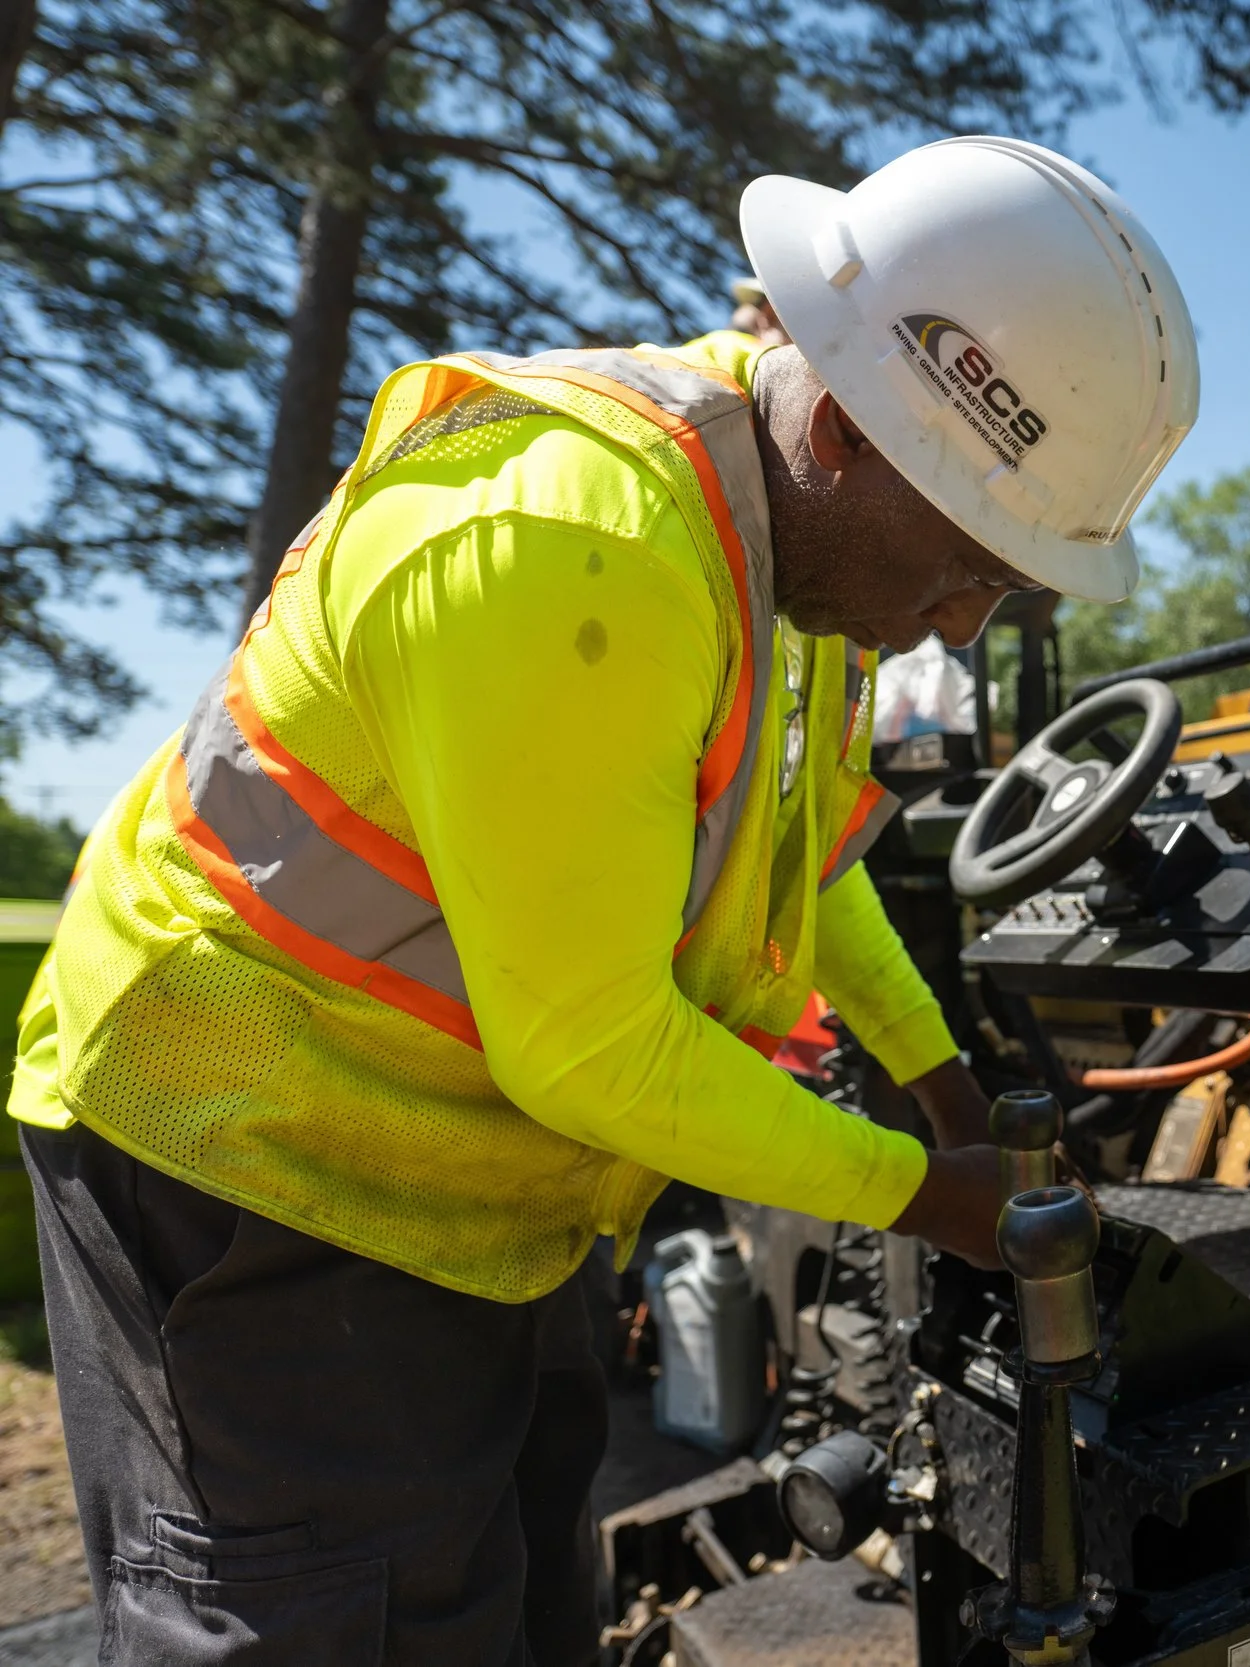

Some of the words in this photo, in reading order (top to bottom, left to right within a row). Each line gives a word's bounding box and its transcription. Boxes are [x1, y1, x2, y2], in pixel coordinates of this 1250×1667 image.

[891, 324, 917, 355] PAVING
[919, 359, 951, 398] GRADING
[953, 399, 969, 418] SITE
[967, 416, 1018, 470] DEVELOPMENT
[943, 366, 1025, 457] INFRASTRUCTURE
[954, 346, 1047, 446] SCS
